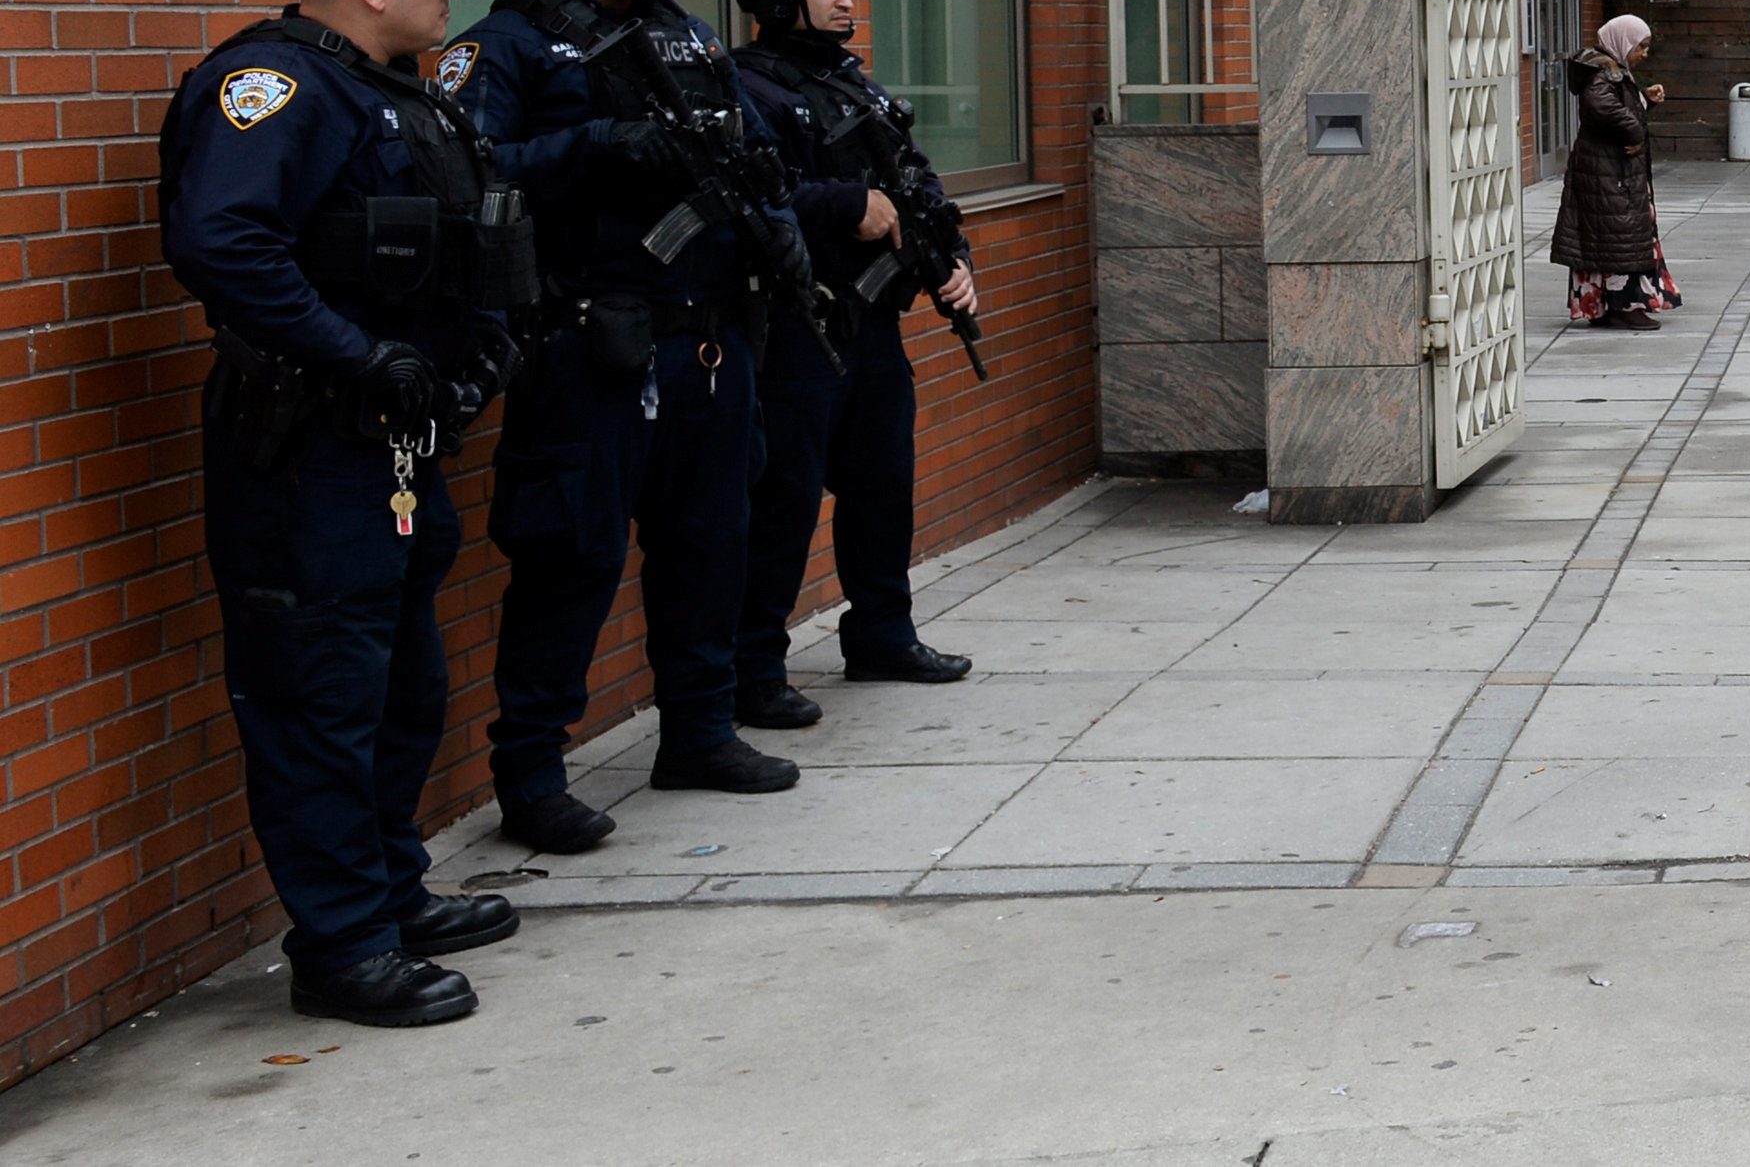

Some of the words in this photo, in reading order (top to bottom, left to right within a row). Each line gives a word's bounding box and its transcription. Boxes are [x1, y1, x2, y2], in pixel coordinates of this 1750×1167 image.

[654, 40, 694, 63] LICE
[244, 72, 278, 81] POLICE
[228, 79, 288, 91] DEPARTMENT
[224, 94, 233, 109] CITY
[267, 94, 287, 109] YORK
